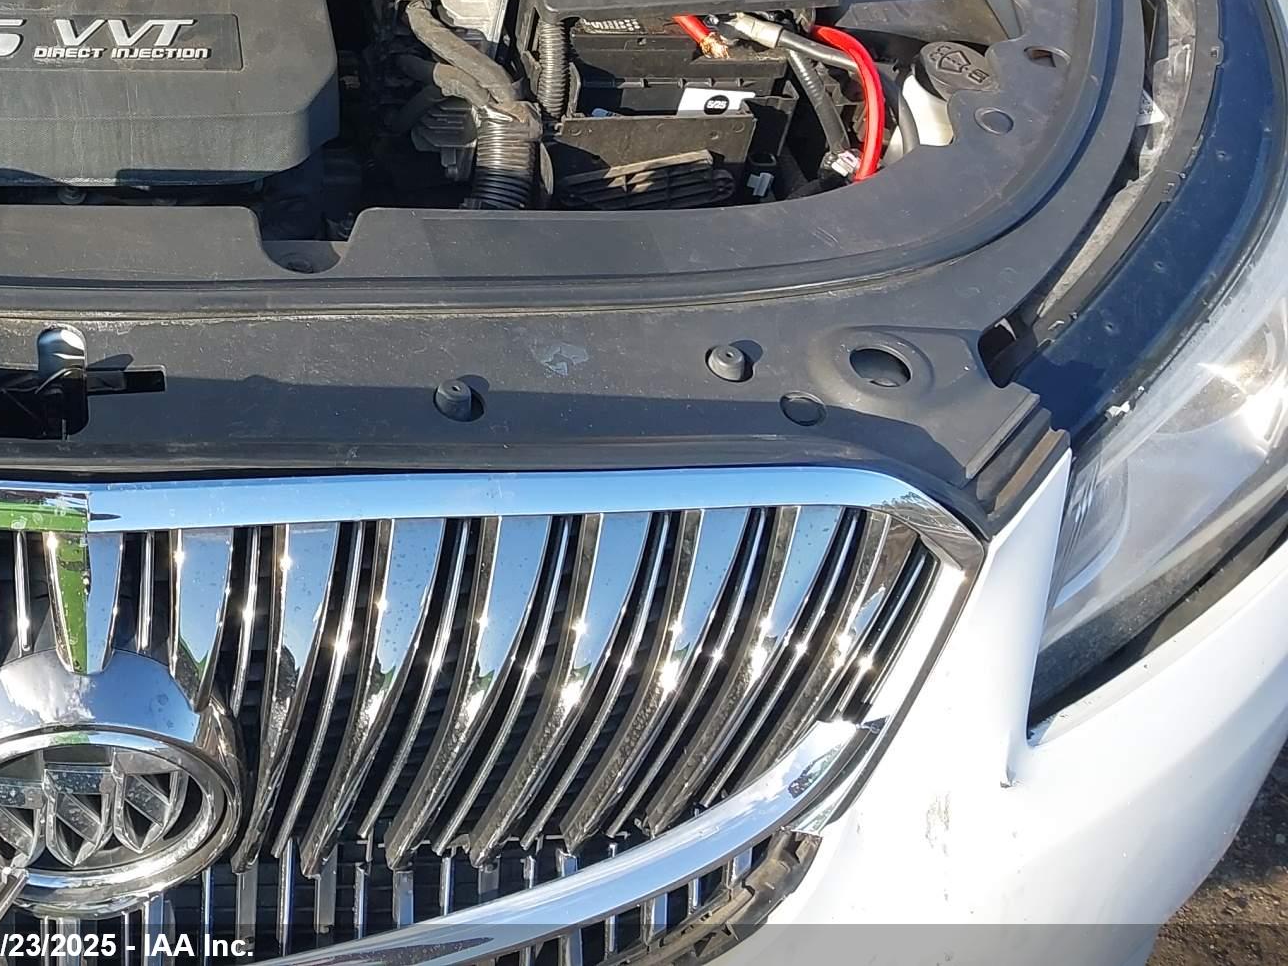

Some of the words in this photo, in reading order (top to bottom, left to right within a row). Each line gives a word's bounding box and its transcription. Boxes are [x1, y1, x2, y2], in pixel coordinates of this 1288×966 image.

[54, 18, 196, 47] VVT
[33, 46, 103, 60] DIRECT
[111, 46, 210, 60] INJECTION
